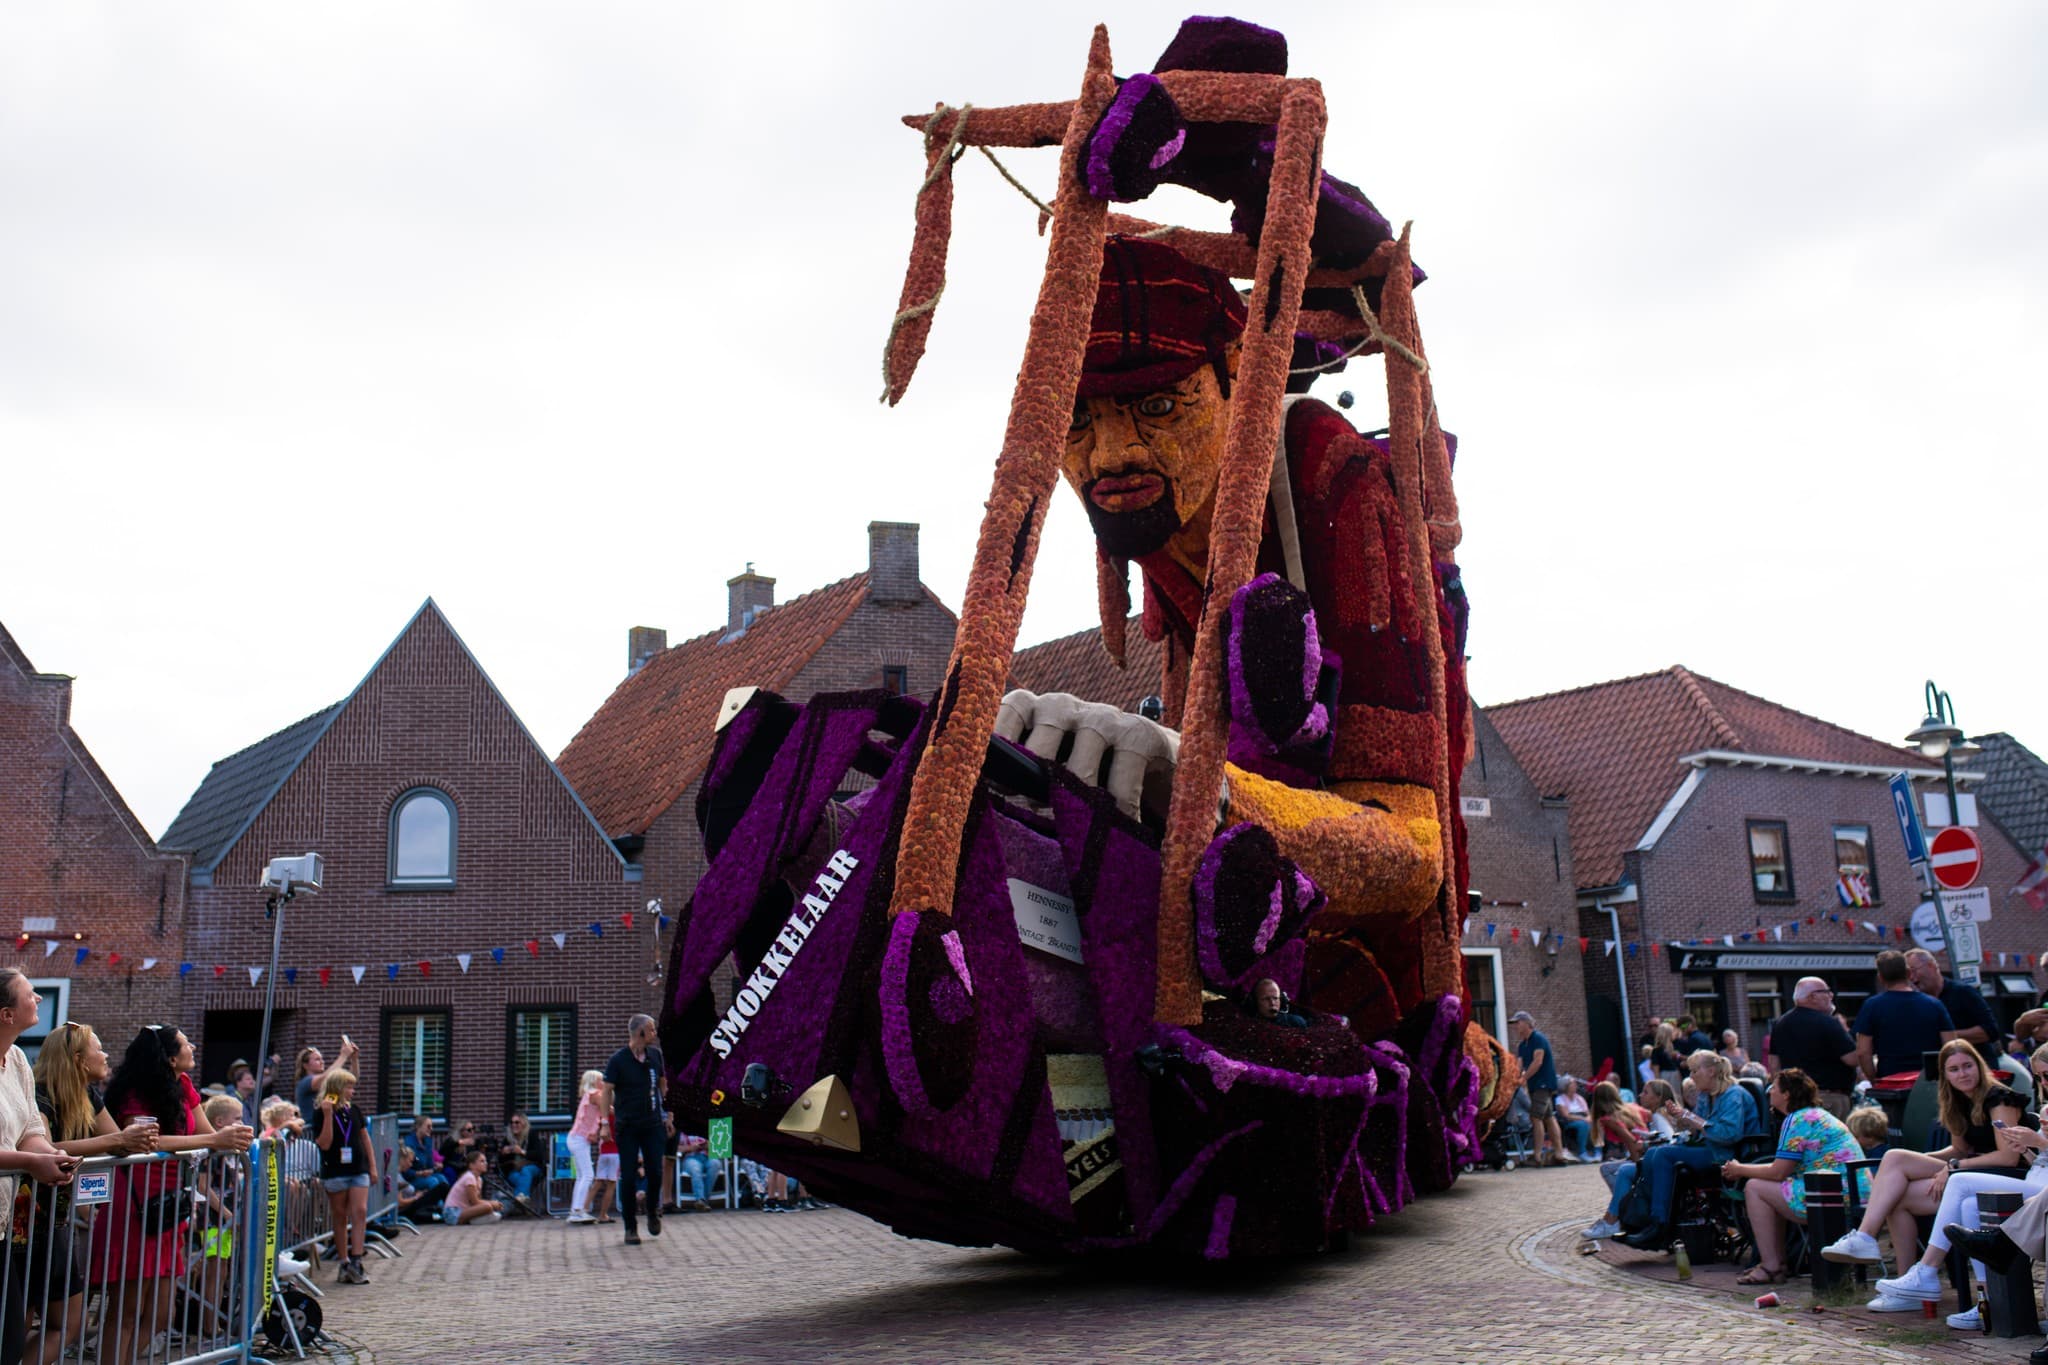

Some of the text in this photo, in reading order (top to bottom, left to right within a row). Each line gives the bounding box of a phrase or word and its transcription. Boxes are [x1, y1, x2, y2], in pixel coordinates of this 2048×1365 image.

[1895, 789, 1912, 851] P
[1027, 891, 1073, 914] HENNESSY
[709, 849, 859, 1060] SMOKKELAAR
